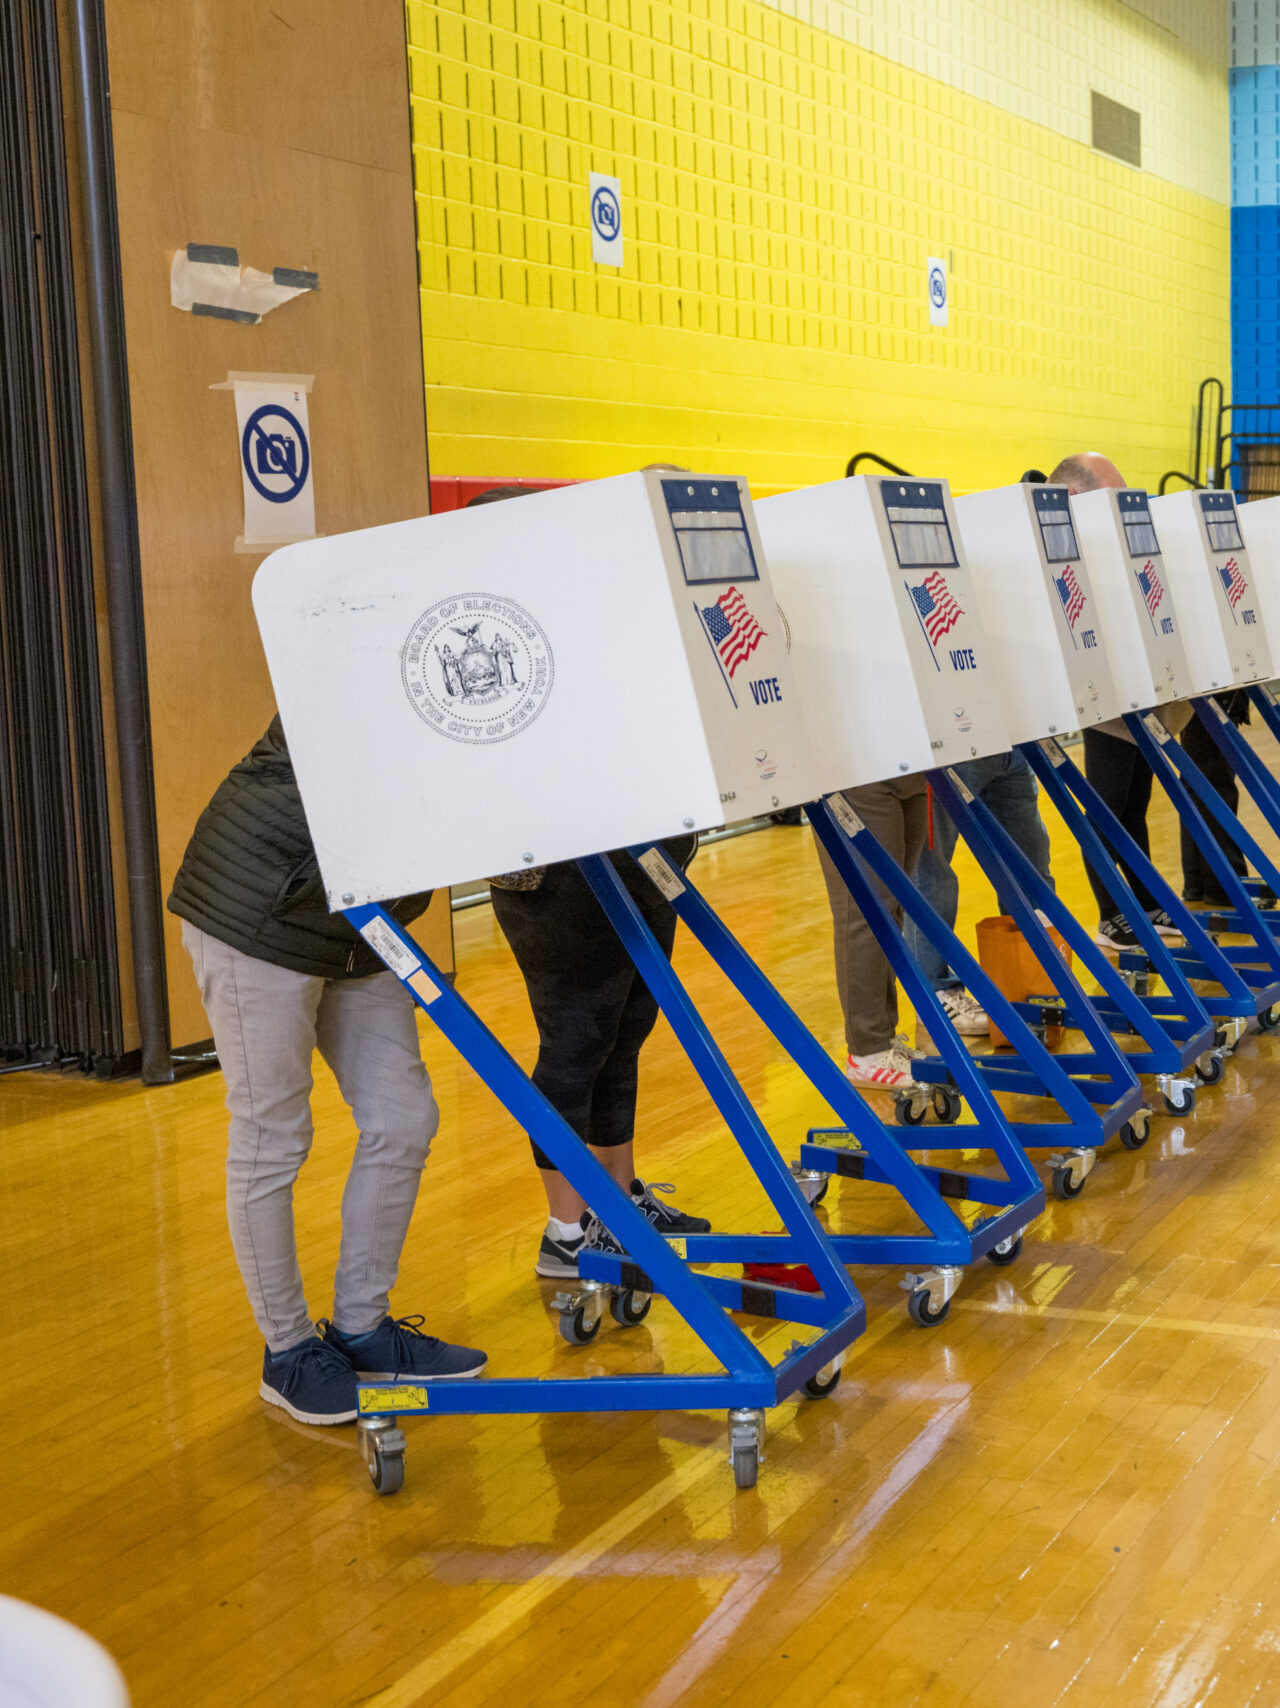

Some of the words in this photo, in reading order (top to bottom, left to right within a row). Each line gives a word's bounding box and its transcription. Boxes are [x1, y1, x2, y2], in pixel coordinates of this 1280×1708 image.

[1160, 617, 1174, 635] VOTE
[1241, 609, 1256, 625] VOTE
[408, 616, 439, 664] BOARD
[440, 602, 458, 618] OF
[463, 599, 537, 640] ELECTIONS
[1080, 629, 1097, 649] VOTE
[949, 649, 977, 671] VOTE
[410, 681, 424, 697] IN
[421, 698, 446, 724] THE
[448, 721, 483, 736] CITY
[486, 722, 505, 736] OF
[507, 698, 536, 727] NEW
[531, 656, 547, 696] YORK
[749, 677, 782, 706] VOTE
